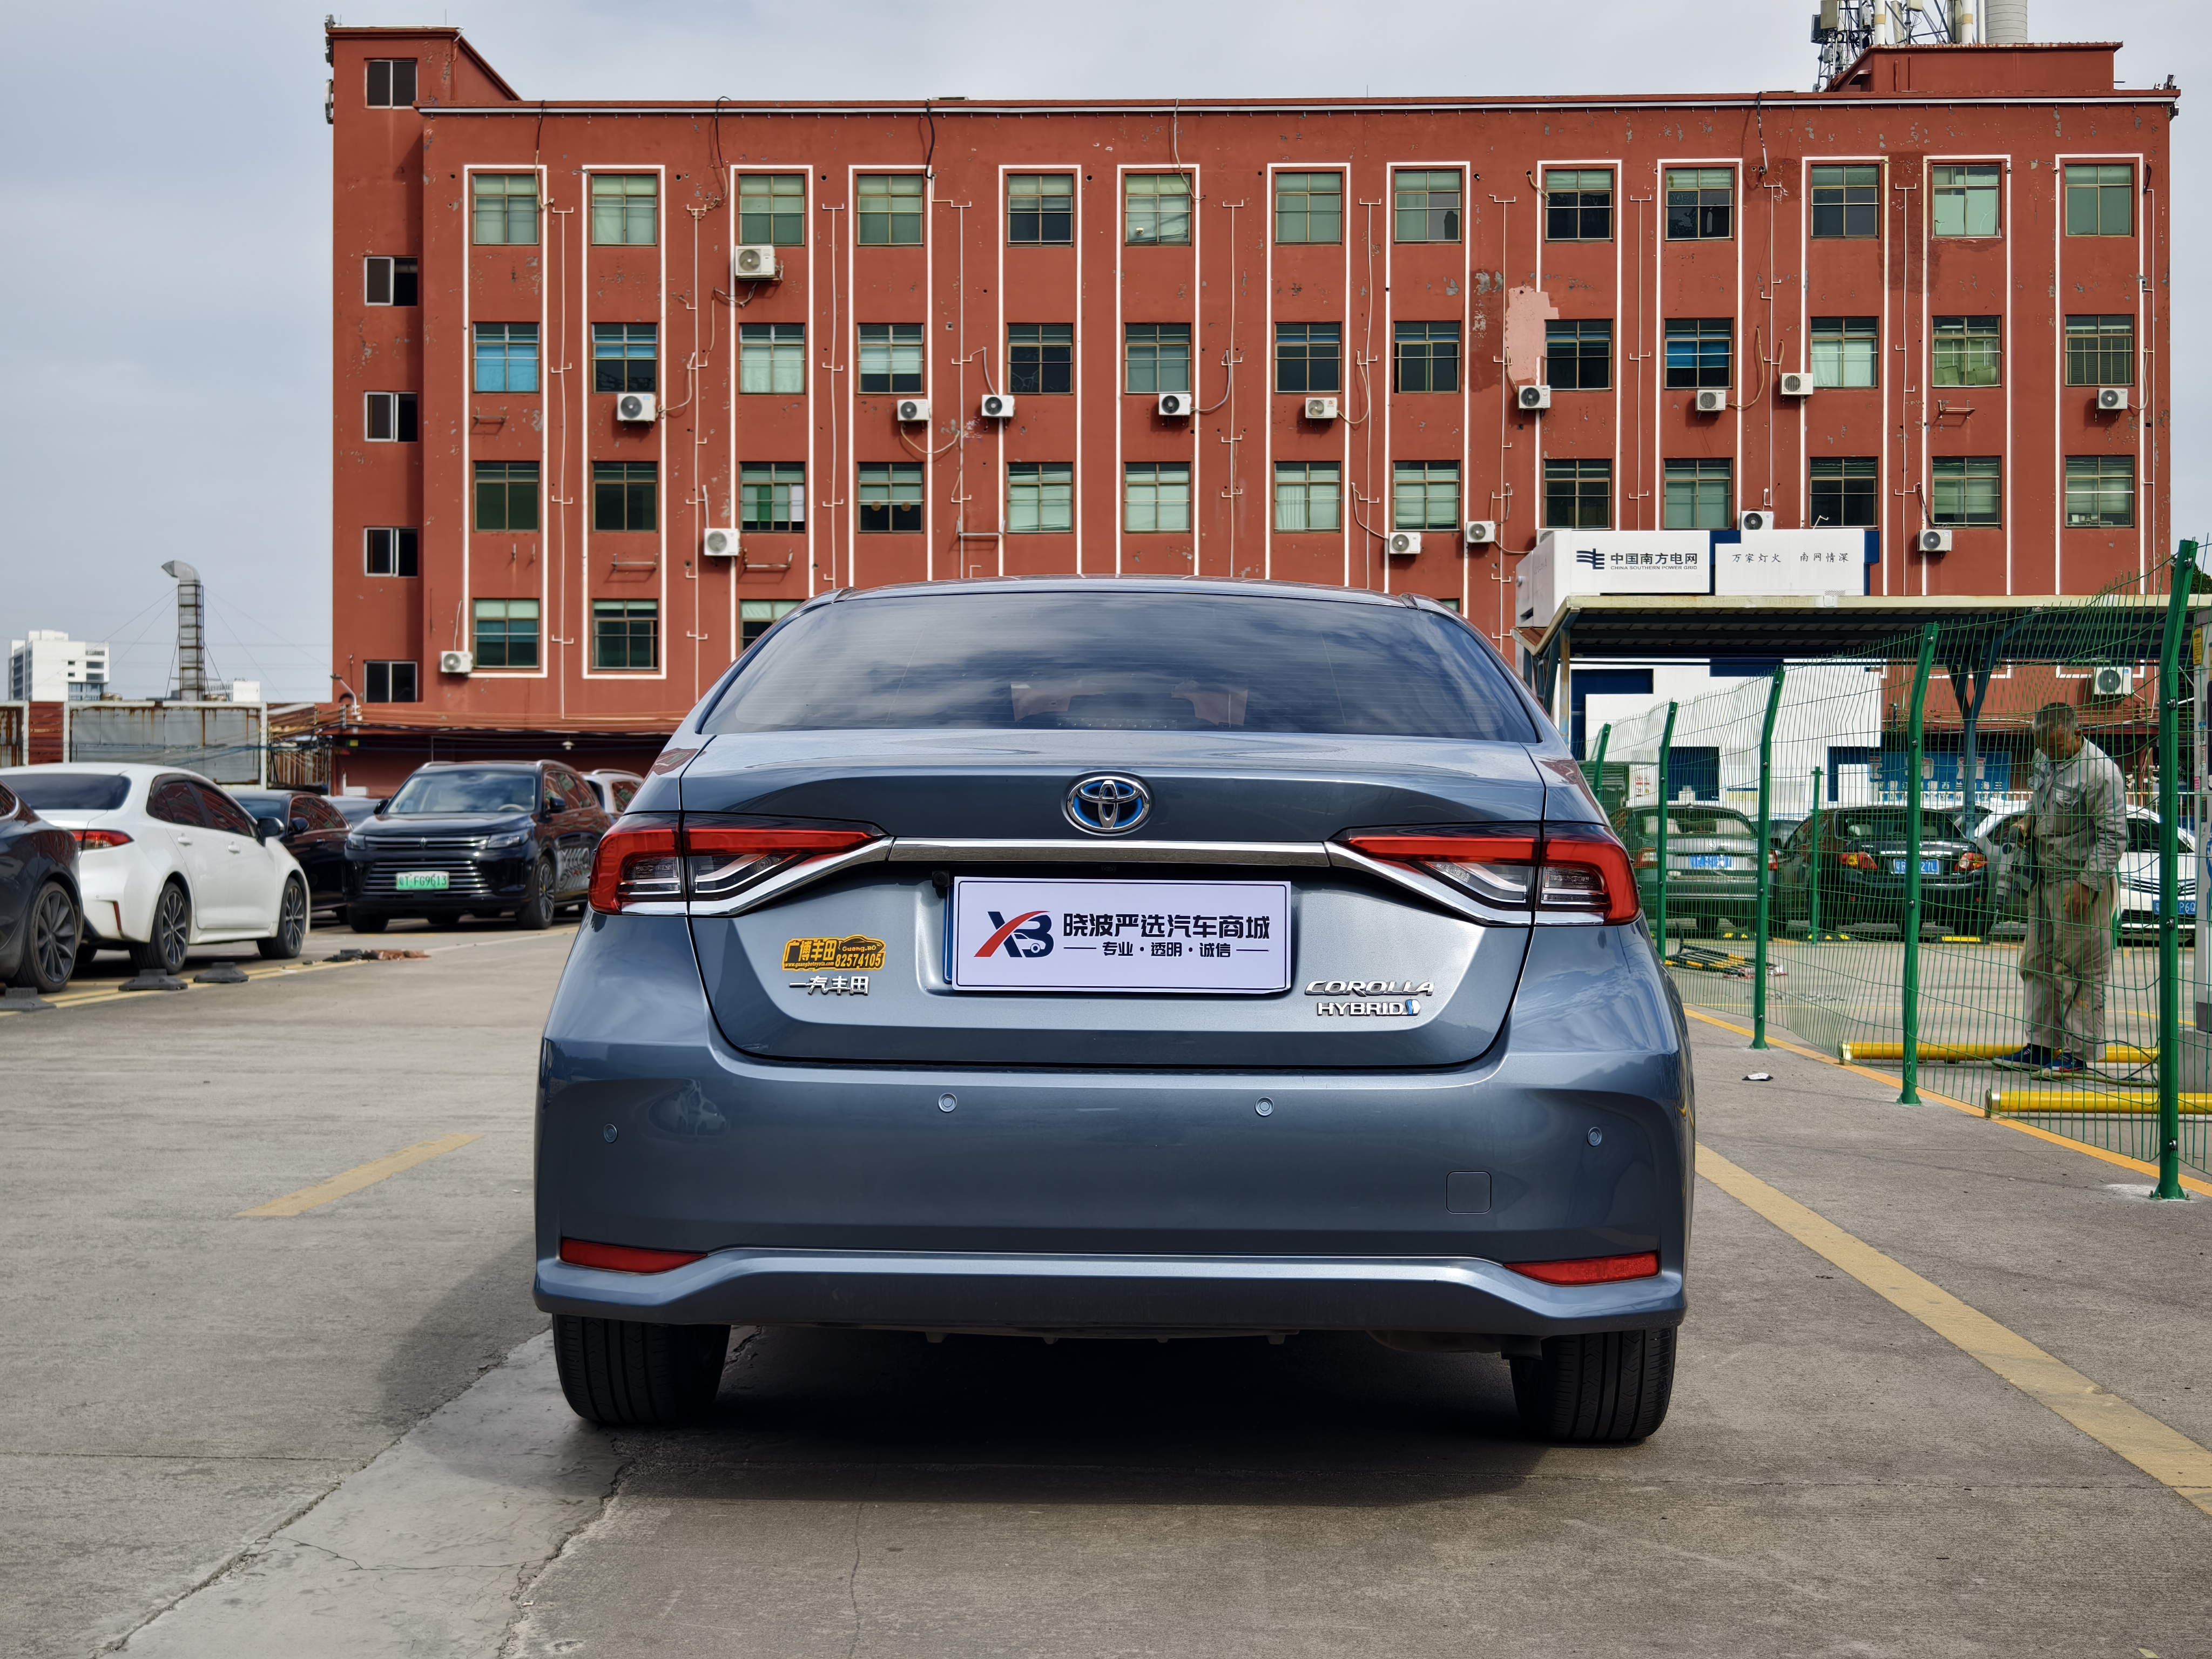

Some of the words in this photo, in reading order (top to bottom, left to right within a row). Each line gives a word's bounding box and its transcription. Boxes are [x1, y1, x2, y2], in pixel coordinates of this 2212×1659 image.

[1610, 552, 1697, 565] 中国南方电网
[1732, 553, 1782, 563] 万家灯火
[1800, 552, 1849, 563] 南网情深
[1063, 913, 1270, 940] 晓波严选汽车商城
[785, 940, 837, 962] 广博丰田
[835, 953, 882, 967] 82574105
[789, 975, 869, 996] 一汽丰田
[1305, 980, 1435, 996] COROLLA
[1317, 1002, 1405, 1016] HYBRID
